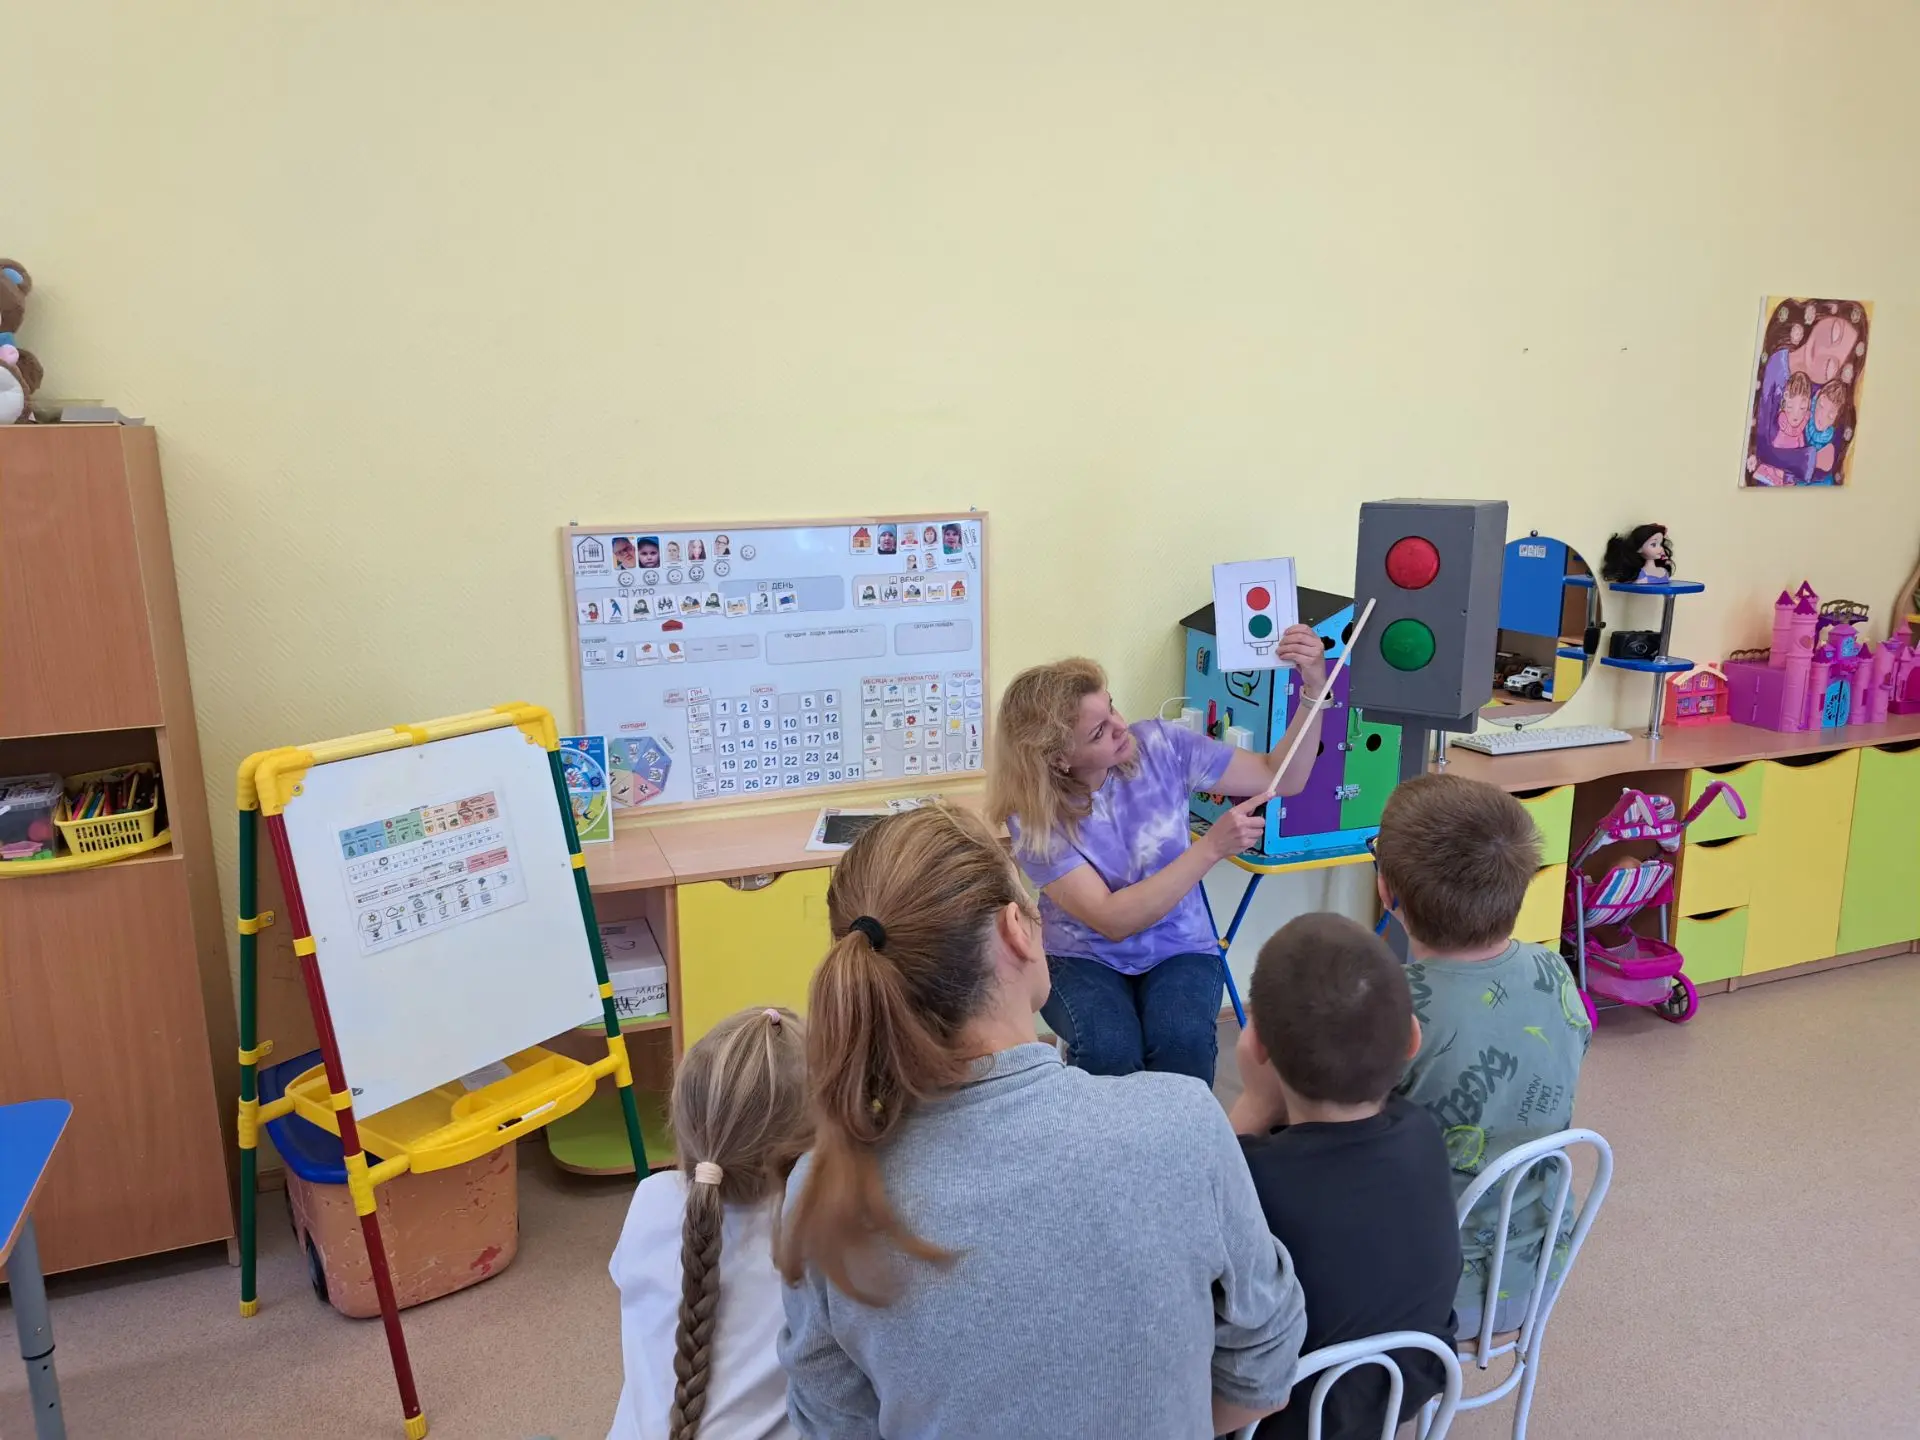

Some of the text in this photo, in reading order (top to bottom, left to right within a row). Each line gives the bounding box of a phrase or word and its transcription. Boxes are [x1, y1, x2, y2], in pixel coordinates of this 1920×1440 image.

[631, 588, 655, 596] УТРО
[771, 581, 794, 590] ДЕНЬ
[617, 651, 623, 659] 4
[722, 695, 832, 712] 1 2 3 5 6
[721, 723, 726, 731] 7
[744, 720, 750, 728] 8
[765, 720, 770, 728] 9
[784, 719, 796, 727] 10
[826, 714, 837, 722] 12
[722, 744, 734, 752] 13
[742, 740, 753, 748] 14
[765, 741, 777, 749] 15
[785, 736, 797, 745] 16
[808, 735, 819, 743] 17
[827, 732, 839, 740] 18
[723, 752, 838, 769] 19 20 21 22 23 24
[721, 780, 733, 788] 25
[745, 780, 758, 789] 26
[765, 776, 777, 784] 27
[787, 775, 799, 784] 28
[807, 772, 819, 780] 29
[829, 771, 841, 780] 30
[848, 768, 858, 776] 31
[1517, 1073, 1544, 1127] MOMENT
[1536, 1085, 1553, 1115] EACH
